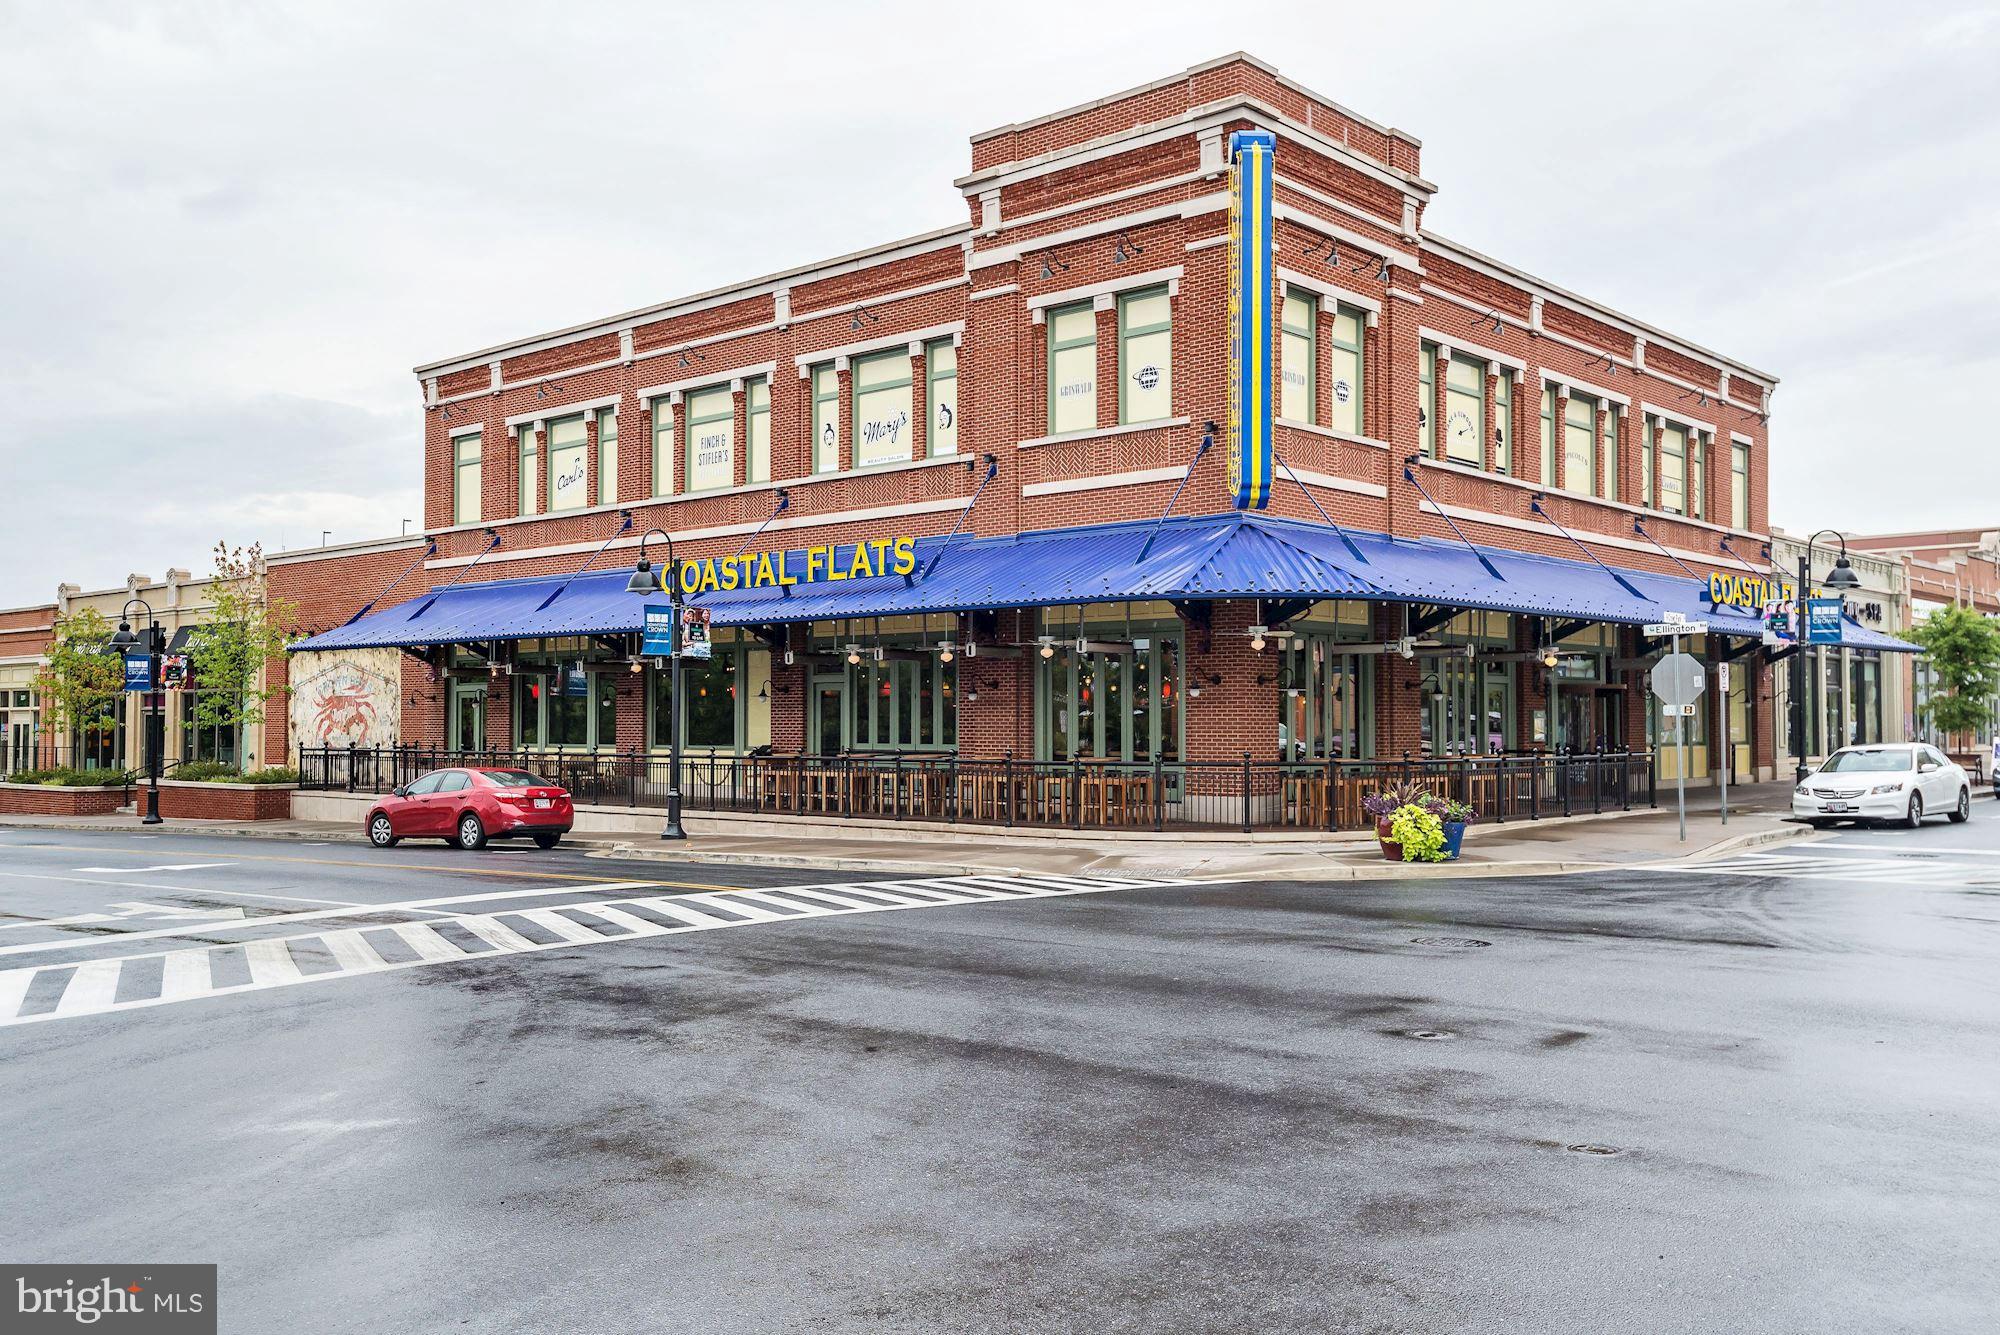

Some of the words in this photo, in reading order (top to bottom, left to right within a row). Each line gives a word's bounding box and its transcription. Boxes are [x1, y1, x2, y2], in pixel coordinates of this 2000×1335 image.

[863, 411, 907, 445] Mary's
[701, 435, 720, 449] FINCH
[721, 433, 726, 447] &
[698, 449, 729, 466] STIFLER'S
[660, 551, 797, 595] COASTAL
[806, 536, 917, 583] FLATS
[1812, 617, 1838, 625] CROWN
[1655, 625, 1696, 634] Ellington
